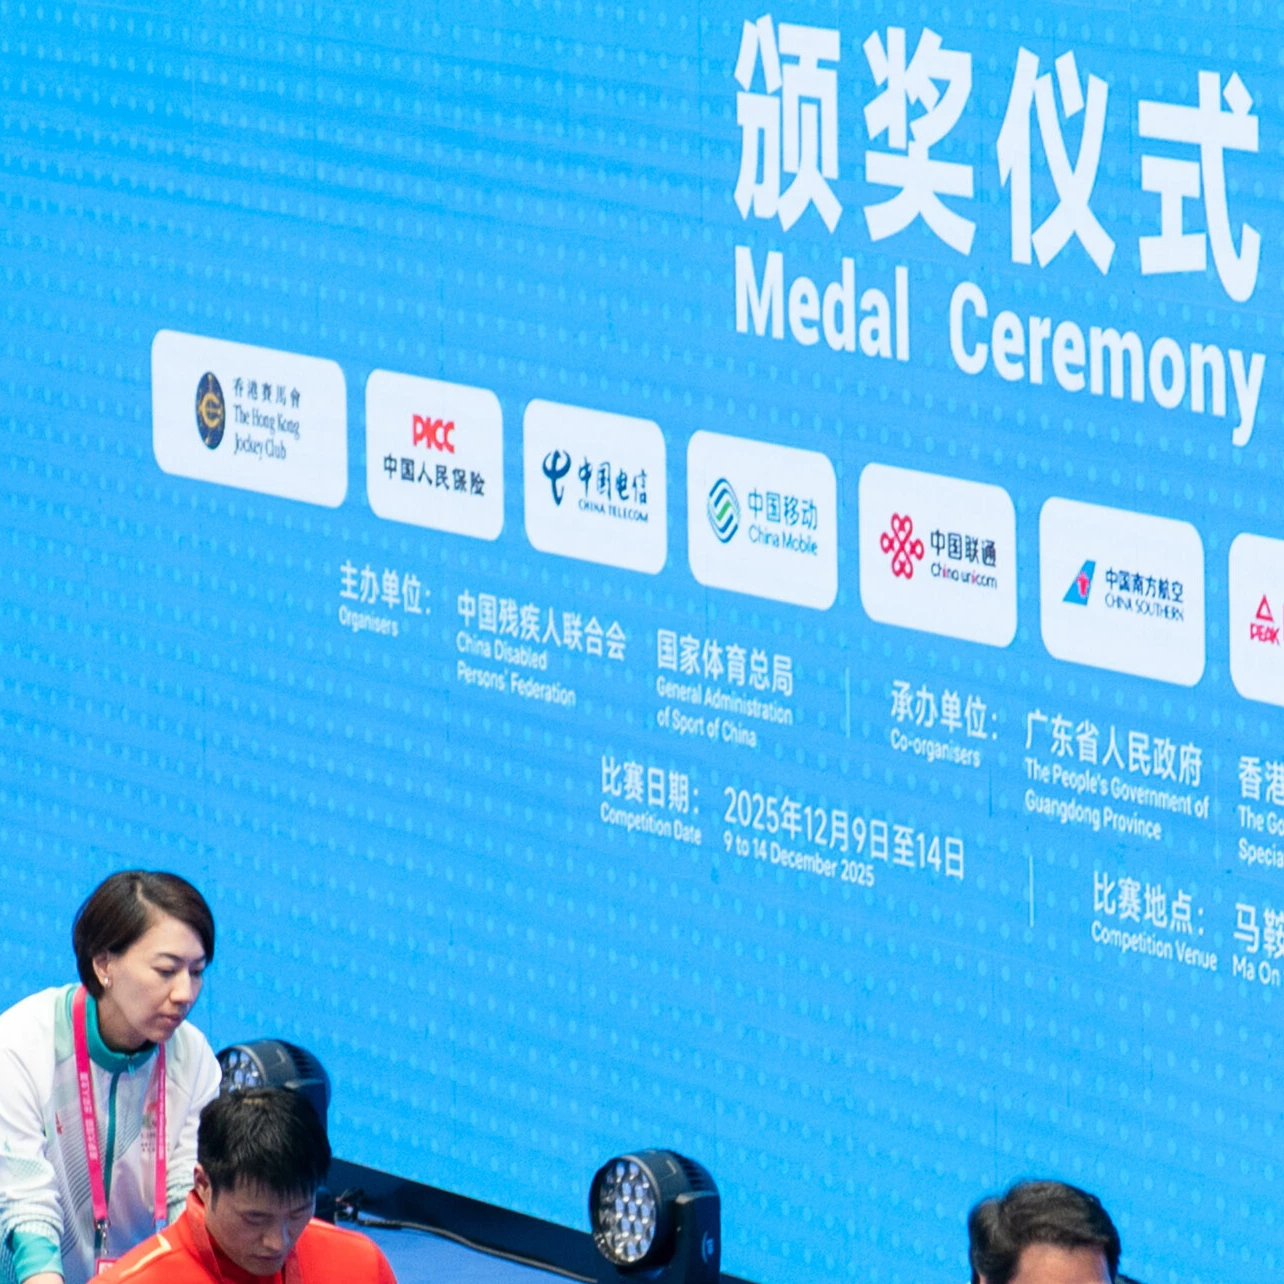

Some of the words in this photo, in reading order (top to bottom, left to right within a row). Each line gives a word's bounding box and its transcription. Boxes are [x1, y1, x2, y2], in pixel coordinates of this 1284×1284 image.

[733, 14, 1261, 303] 颁奖仪式
[733, 246, 910, 362] Medal
[949, 281, 1266, 448] Ceremony
[233, 377, 301, 409] 香港賽馬會
[233, 404, 250, 426] The
[251, 410, 276, 433] Hong
[276, 414, 300, 441] Kong
[412, 413, 455, 454] PICC
[233, 432, 264, 461] Jockey
[265, 441, 287, 460] Club
[383, 454, 485, 496] 中国人民保险
[578, 455, 648, 505] 中国电信
[578, 498, 605, 515] CHINA
[608, 504, 649, 523] TELECOM
[748, 487, 818, 530] 中国移动
[748, 524, 780, 548] China
[782, 531, 818, 556] Mobile
[930, 529, 997, 567] 中国联通
[1105, 567, 1184, 603] 中国南方航空
[338, 604, 398, 636] Organisers
[457, 589, 626, 660] 中国残疾人联合会
[1105, 594, 1133, 611] CHINA
[1136, 599, 1184, 621] SOUTHERN
[455, 630, 491, 658] China
[494, 638, 547, 670] Disabled
[1250, 623, 1280, 645] PEAK
[456, 660, 507, 691] Persons'
[510, 671, 575, 705] Federation
[657, 628, 792, 696] 国家体育总局
[656, 675, 701, 704] General
[703, 686, 792, 724] Administration
[656, 706, 670, 726] of
[671, 708, 704, 735] Sport
[706, 718, 720, 738] of
[721, 720, 756, 747] China
[1025, 708, 1202, 786] 广东省人民政府
[890, 728, 980, 767] Co-organisers
[1024, 756, 1050, 783] The
[1051, 763, 1108, 796] People's
[1110, 776, 1191, 815] Government
[1193, 795, 1209, 818] of
[600, 801, 671, 836] Competition
[673, 818, 702, 845] Date
[724, 786, 963, 880] 2025年12月9日至14日
[1024, 788, 1100, 831] Guangdong
[1102, 806, 1161, 840] Province
[1237, 804, 1264, 832] The
[723, 830, 733, 851] 9
[735, 834, 749, 856] to
[752, 837, 767, 860] 14
[770, 841, 837, 877] December
[840, 858, 874, 887] 2025
[1091, 920, 1172, 959] Competition
[1174, 939, 1217, 970] Venue
[1232, 954, 1254, 980] Ma
[1258, 961, 1280, 985] On
